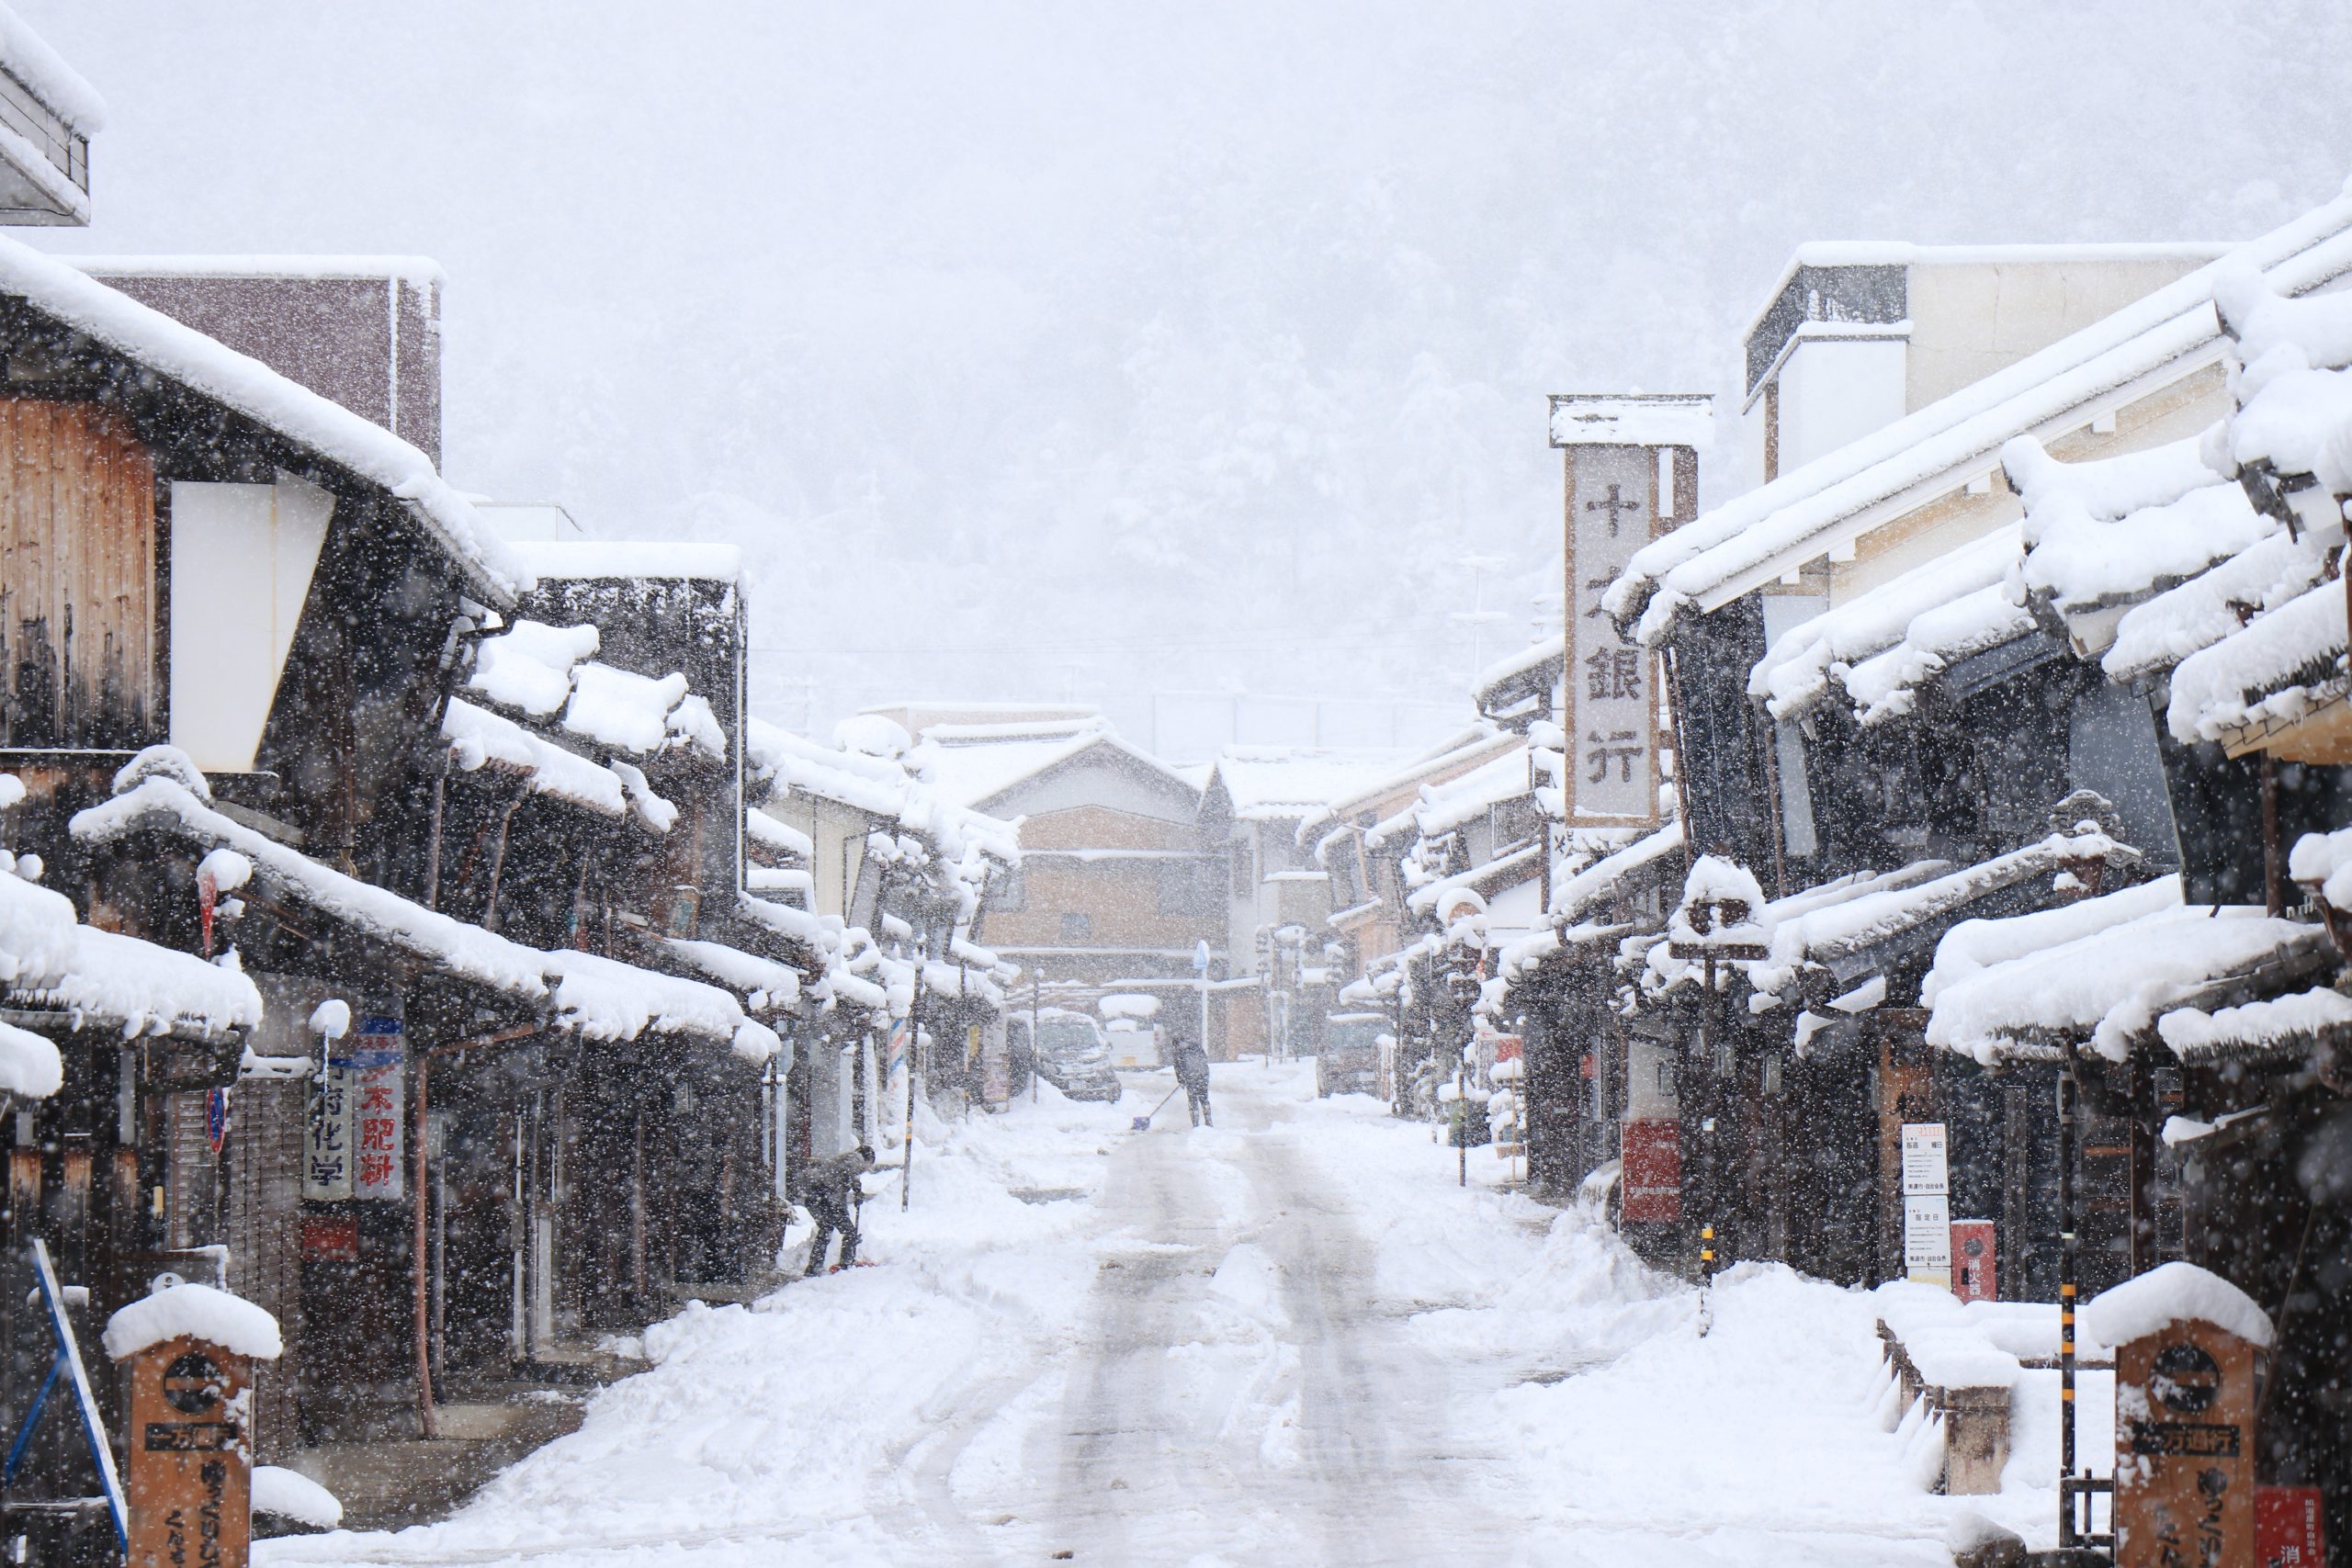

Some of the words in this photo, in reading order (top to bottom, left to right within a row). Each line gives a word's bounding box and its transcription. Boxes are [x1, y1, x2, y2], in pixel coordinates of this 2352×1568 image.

[1968, 1259, 1981, 1295] 消火器
[2280, 1545, 2301, 1568] 消
